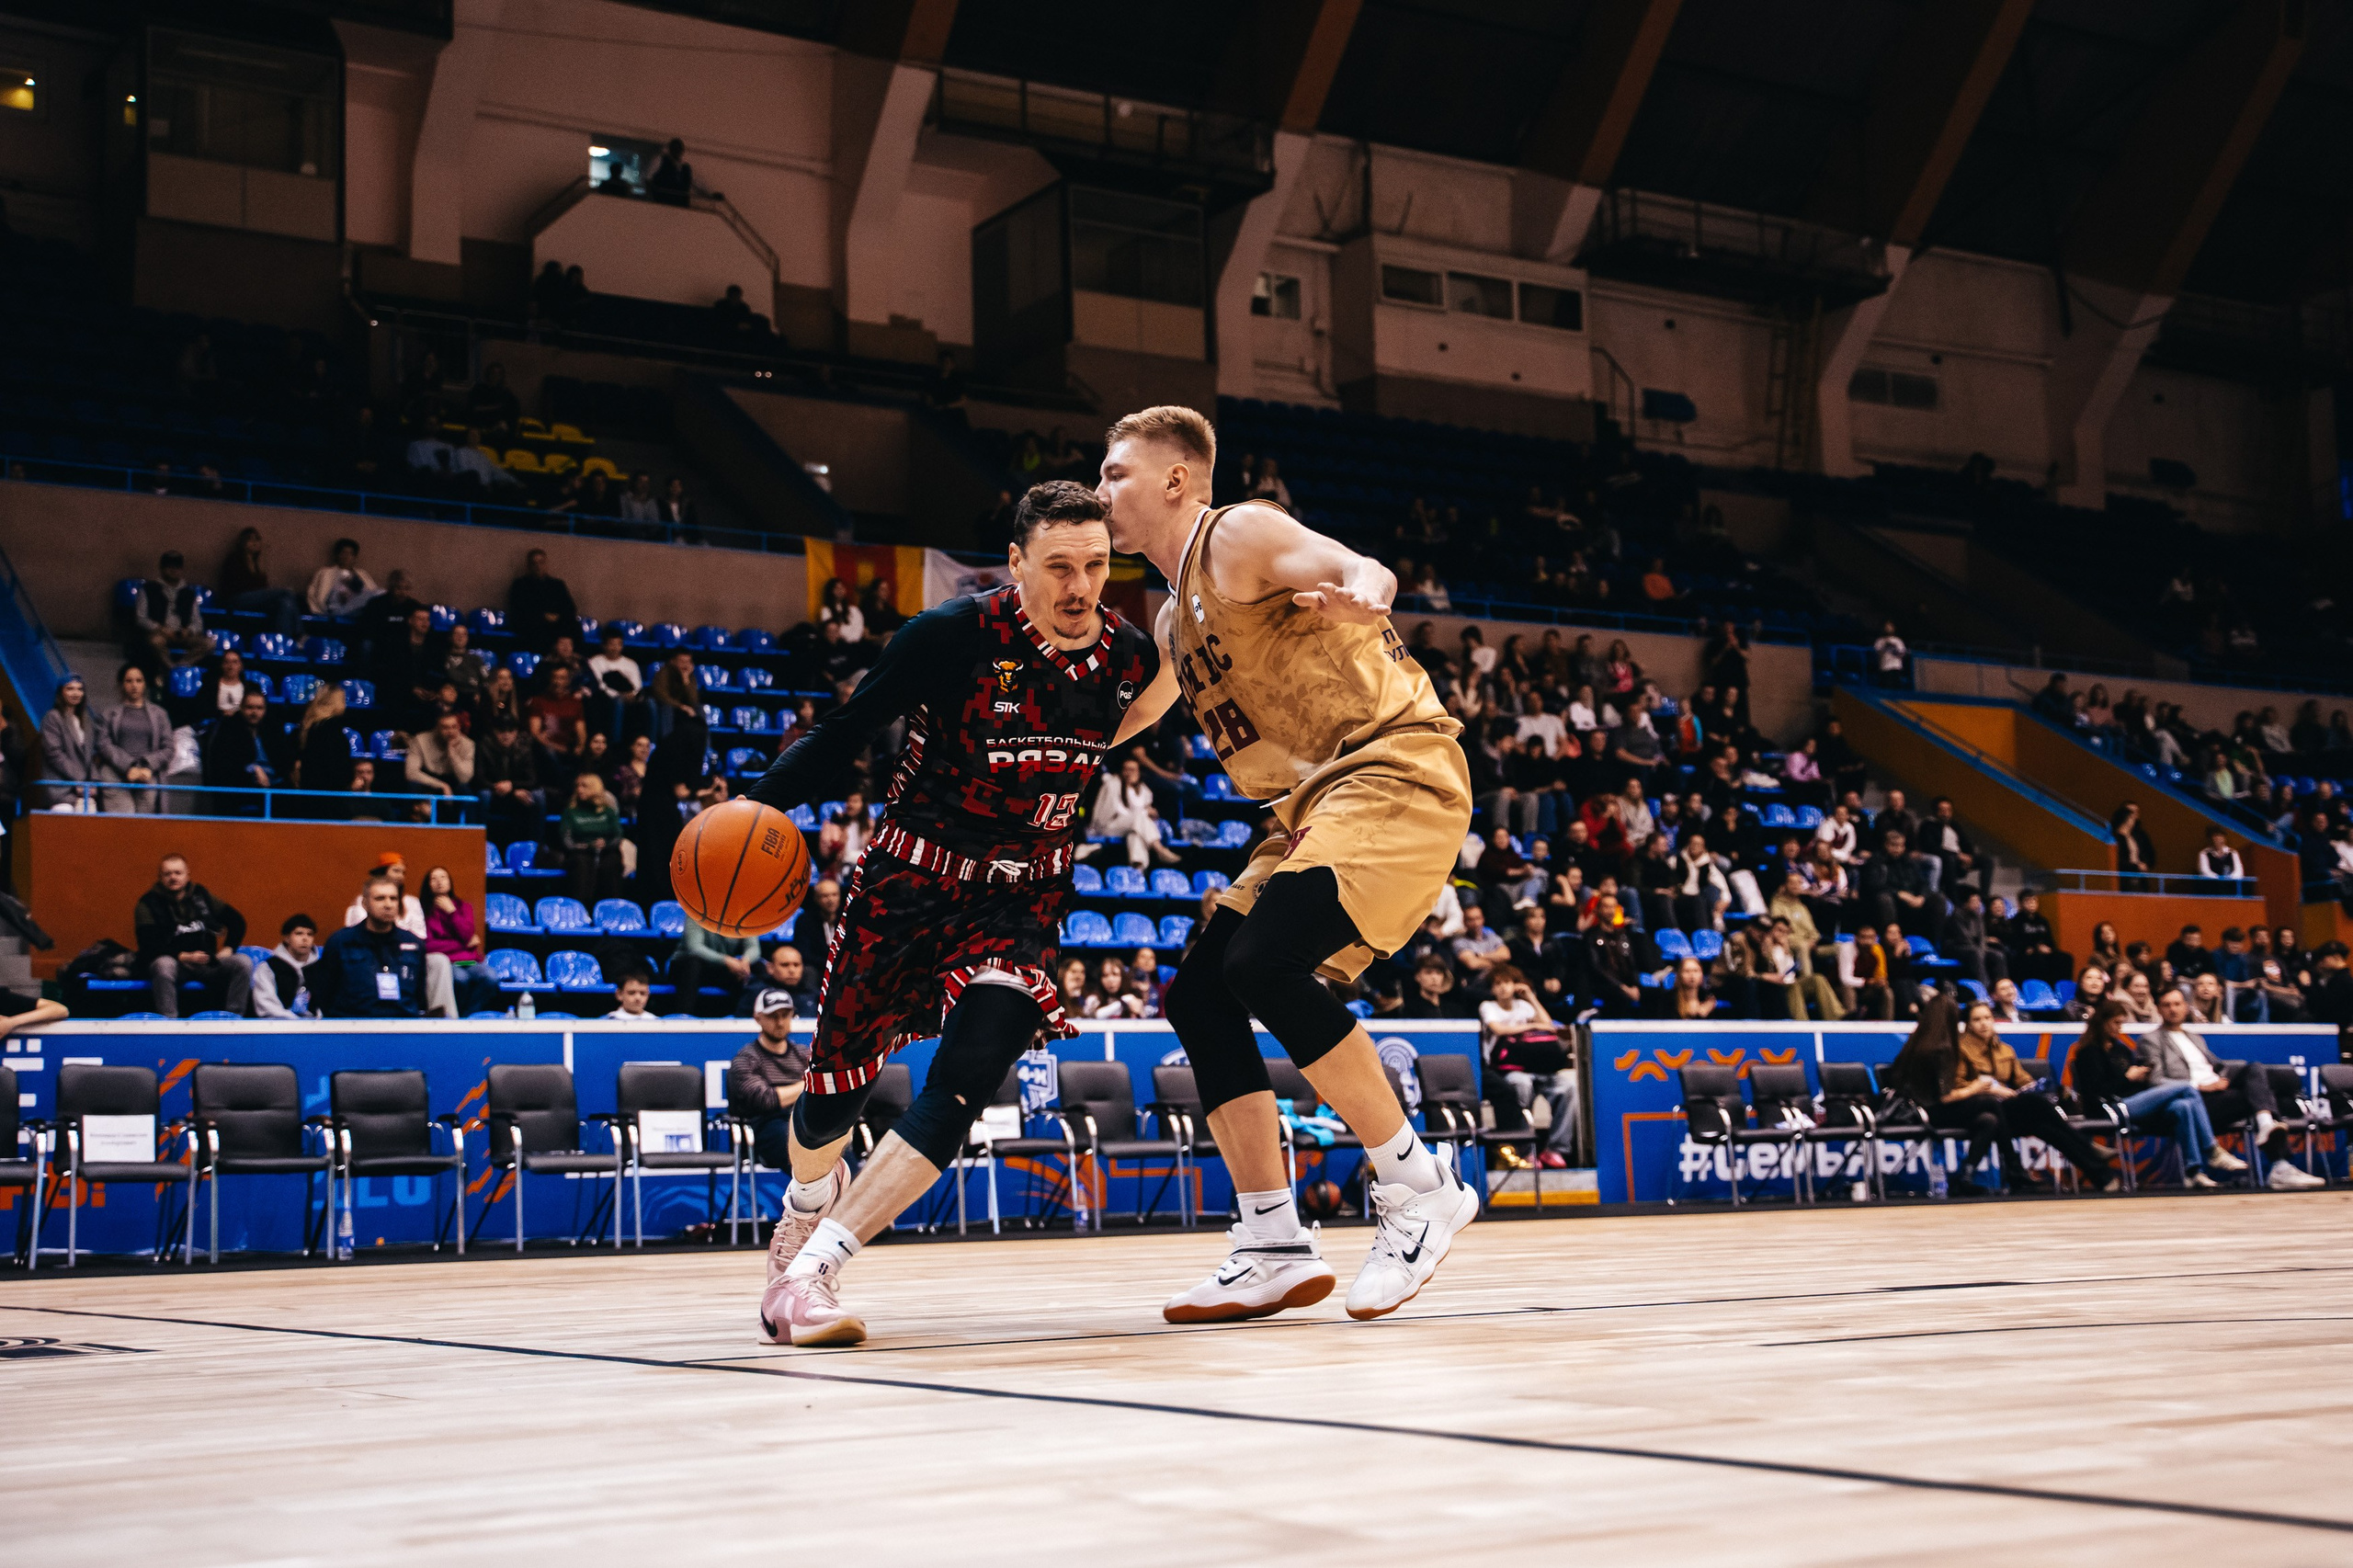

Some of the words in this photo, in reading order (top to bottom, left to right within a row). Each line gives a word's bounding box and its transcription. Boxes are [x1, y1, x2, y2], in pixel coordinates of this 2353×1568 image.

[993, 701, 1020, 713] STK
[1203, 698, 1262, 762] 28
[986, 736, 1107, 752] БАСКЕТБОЛЬНЫЙ
[761, 827, 780, 856] FIBA
